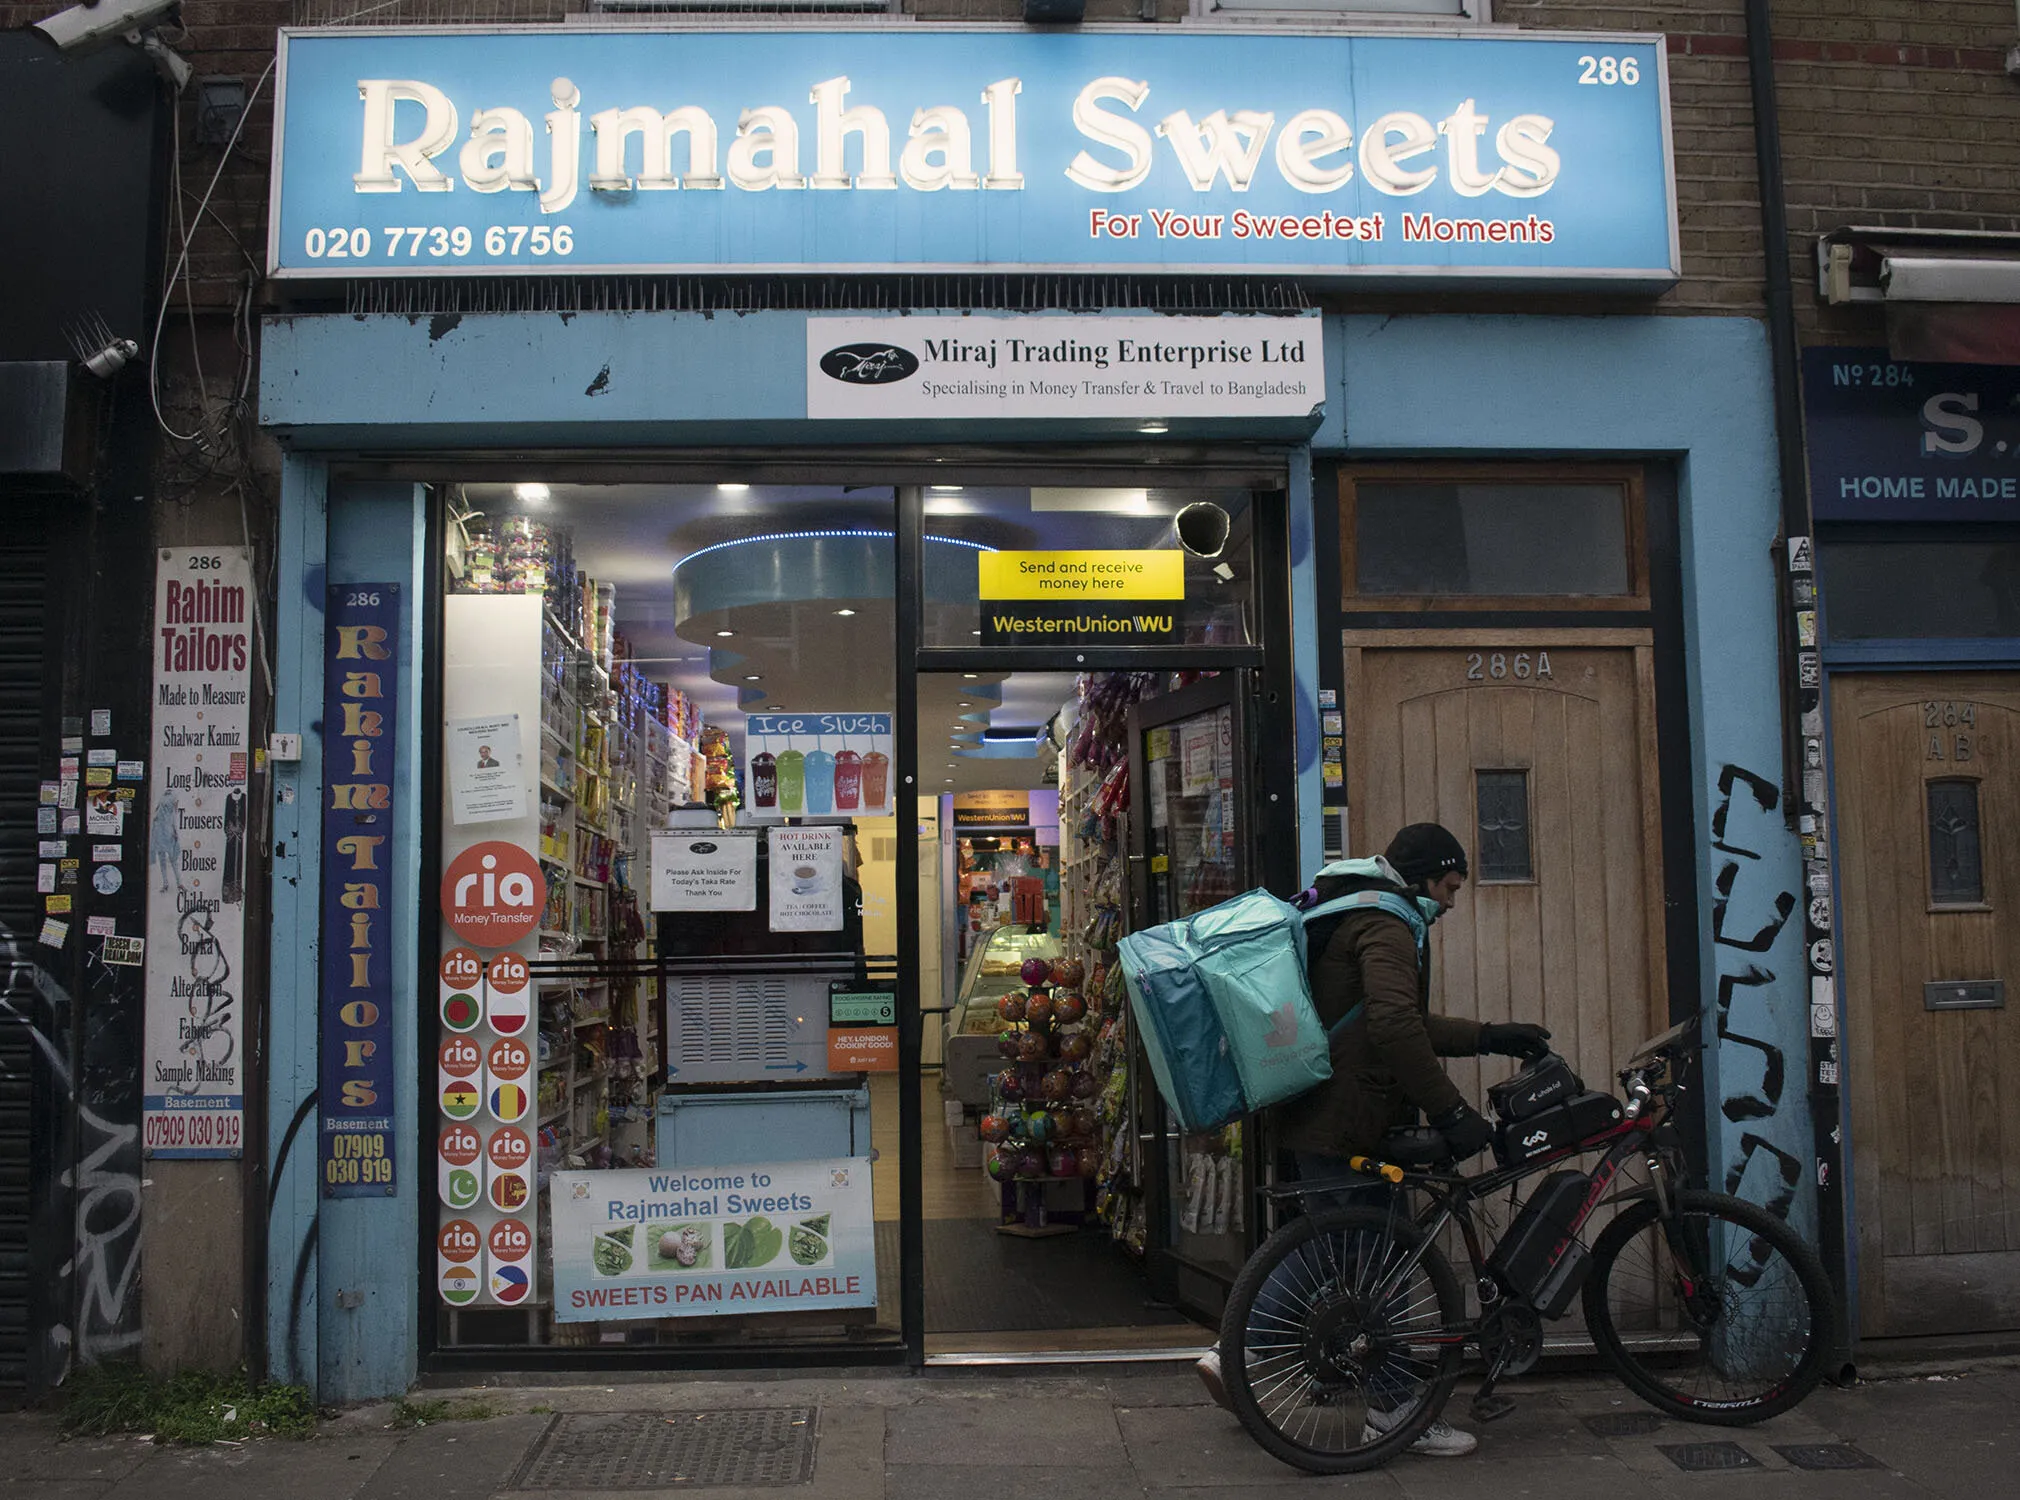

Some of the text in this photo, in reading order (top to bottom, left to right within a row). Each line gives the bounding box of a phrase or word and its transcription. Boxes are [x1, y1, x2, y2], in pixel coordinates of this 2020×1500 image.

[1577, 56, 1640, 87] 286
[353, 75, 1563, 214] Rajmahal Sweets
[1091, 208, 1555, 244] For Your Sweetest Moments
[305, 225, 574, 259] 020 7739 6756
[923, 338, 1306, 369] Miraj Trading Enterprise Ltd
[1869, 365, 1915, 387] 284
[922, 380, 1307, 399] Specialising in Money Transfer & Travel to Bangladesh
[1840, 476, 2017, 499] HOME MADE
[188, 556, 222, 570] 286
[1019, 560, 1144, 574] Send and receive
[1039, 577, 1125, 592] money here
[166, 578, 245, 625] Rahim
[347, 592, 380, 607] 286
[993, 615, 1133, 633] WesternUnion
[161, 626, 247, 673] Tailors
[1466, 651, 1554, 680] 286A
[159, 683, 246, 706] Made to Measure
[331, 624, 392, 811] Rahim
[755, 715, 886, 734] Ice Slush
[1924, 701, 1976, 729] 284
[163, 725, 241, 748] Shalwar Kamiz
[1927, 735, 1974, 761] A B
[166, 767, 192, 791] Long
[88, 815, 118, 823] MONER
[178, 808, 223, 830] Trousers
[957, 813, 1011, 822] WesternUnion
[779, 832, 832, 841] HOT DRINK
[779, 842, 832, 851] AVAILABLE
[181, 853, 217, 872] Blouse
[791, 853, 818, 861] HERE
[454, 854, 535, 907] ria
[665, 868, 742, 876] Please Ask Inside For
[671, 878, 736, 887] Today's Taka Rate
[176, 890, 220, 914] Children
[685, 889, 723, 897] Thank You
[454, 912, 534, 926] Money Transfer
[181, 936, 214, 956] Burka
[335, 834, 386, 1108] Tailors
[444, 952, 478, 974] ria
[492, 956, 525, 978] ria
[170, 975, 223, 999] Alteration
[444, 1039, 477, 1062] ria
[492, 1042, 525, 1065] ria
[867, 1041, 894, 1049] GOOD!
[155, 1059, 235, 1085] Sample Making
[164, 1096, 231, 1109] Basement
[146, 1115, 240, 1146] 07909 030 919
[326, 1118, 390, 1131] Basement
[333, 1133, 385, 1159] 07909
[443, 1127, 477, 1150] ria
[493, 1131, 526, 1154] ria
[327, 1157, 393, 1184] 030 919
[648, 1172, 771, 1193] Welcome to
[607, 1191, 813, 1223] Rajmahal Sweets
[443, 1224, 476, 1247] ria
[493, 1223, 527, 1246] ria
[571, 1275, 861, 1309] SWEETS PAN AVAILABLE
